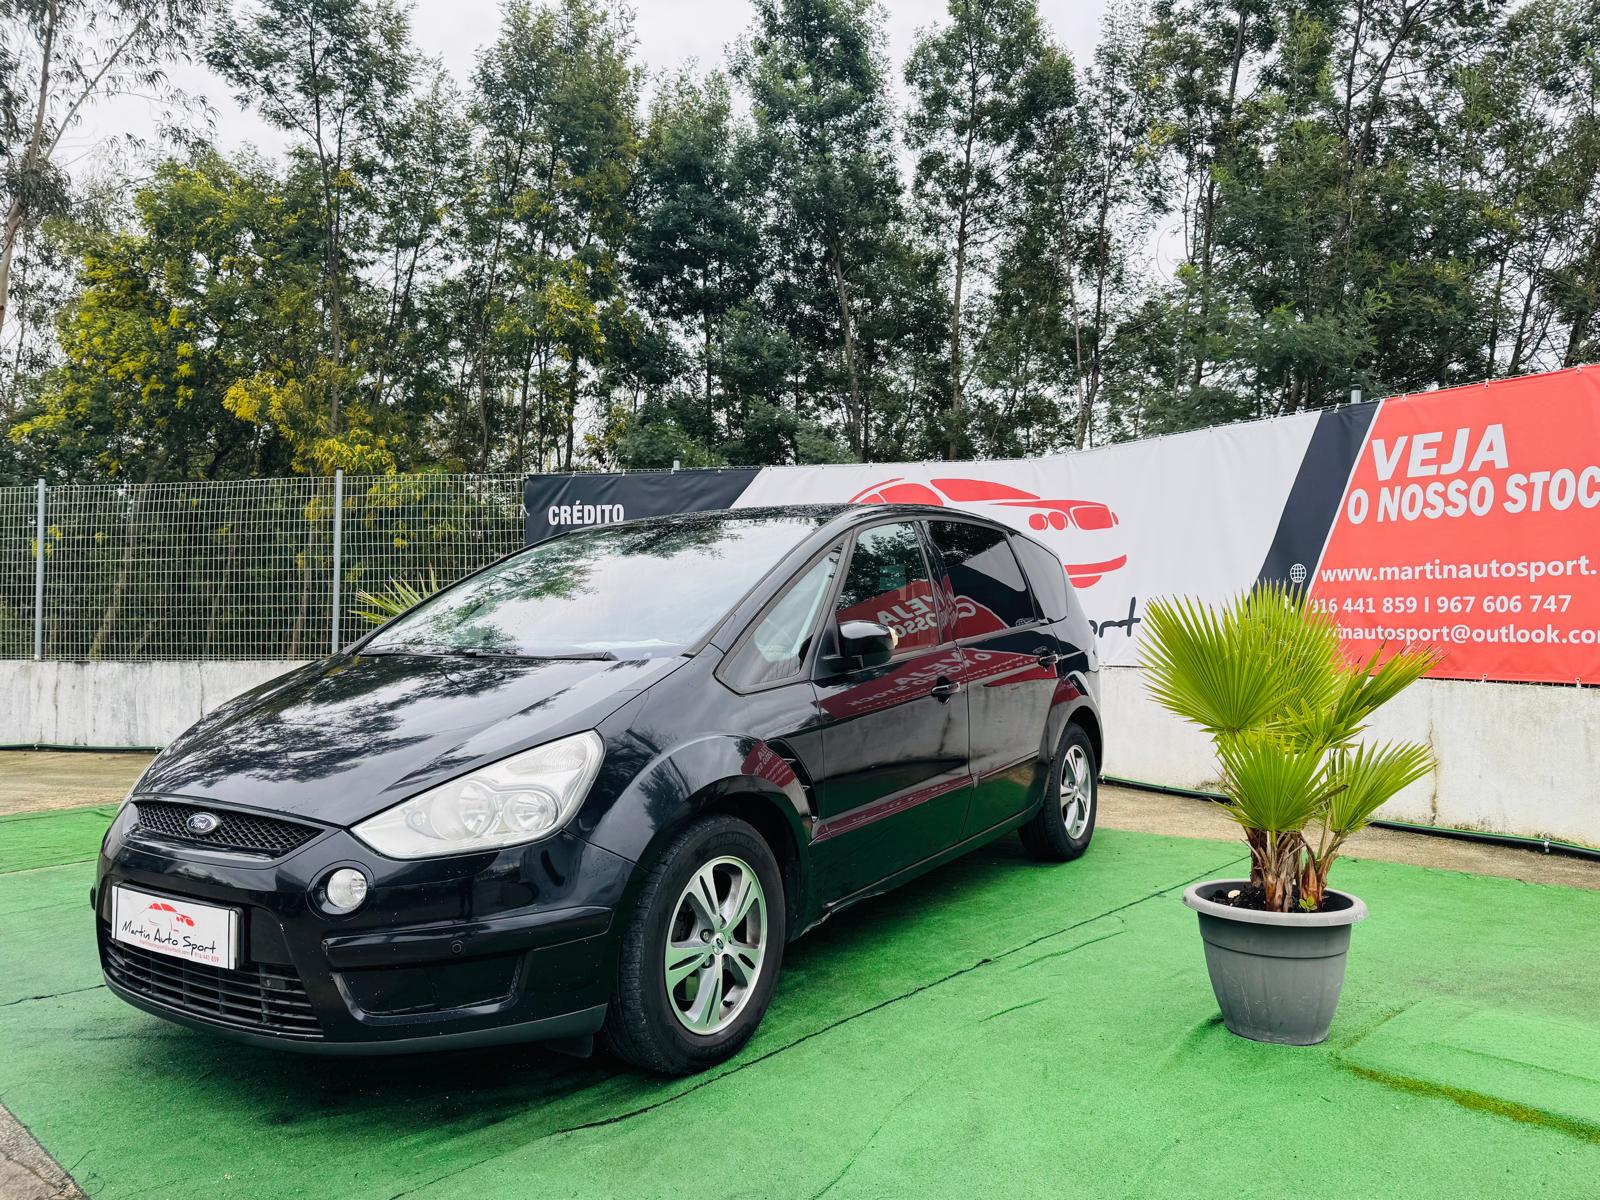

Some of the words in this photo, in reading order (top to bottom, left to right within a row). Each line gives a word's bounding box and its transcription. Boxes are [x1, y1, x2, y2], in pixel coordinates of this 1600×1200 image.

[1372, 424, 1508, 481] VEJA
[548, 499, 625, 526] CRÉDITO
[1347, 488, 1369, 525] O
[1376, 476, 1495, 523] NOSSO
[1342, 597, 1376, 614] 441
[1382, 596, 1418, 614] 859
[1436, 595, 1476, 614] 967
[1483, 595, 1523, 614] 606
[1529, 594, 1572, 614] 747
[121, 920, 151, 940] Martin
[153, 927, 178, 947] Auto
[182, 935, 217, 957] Sport
